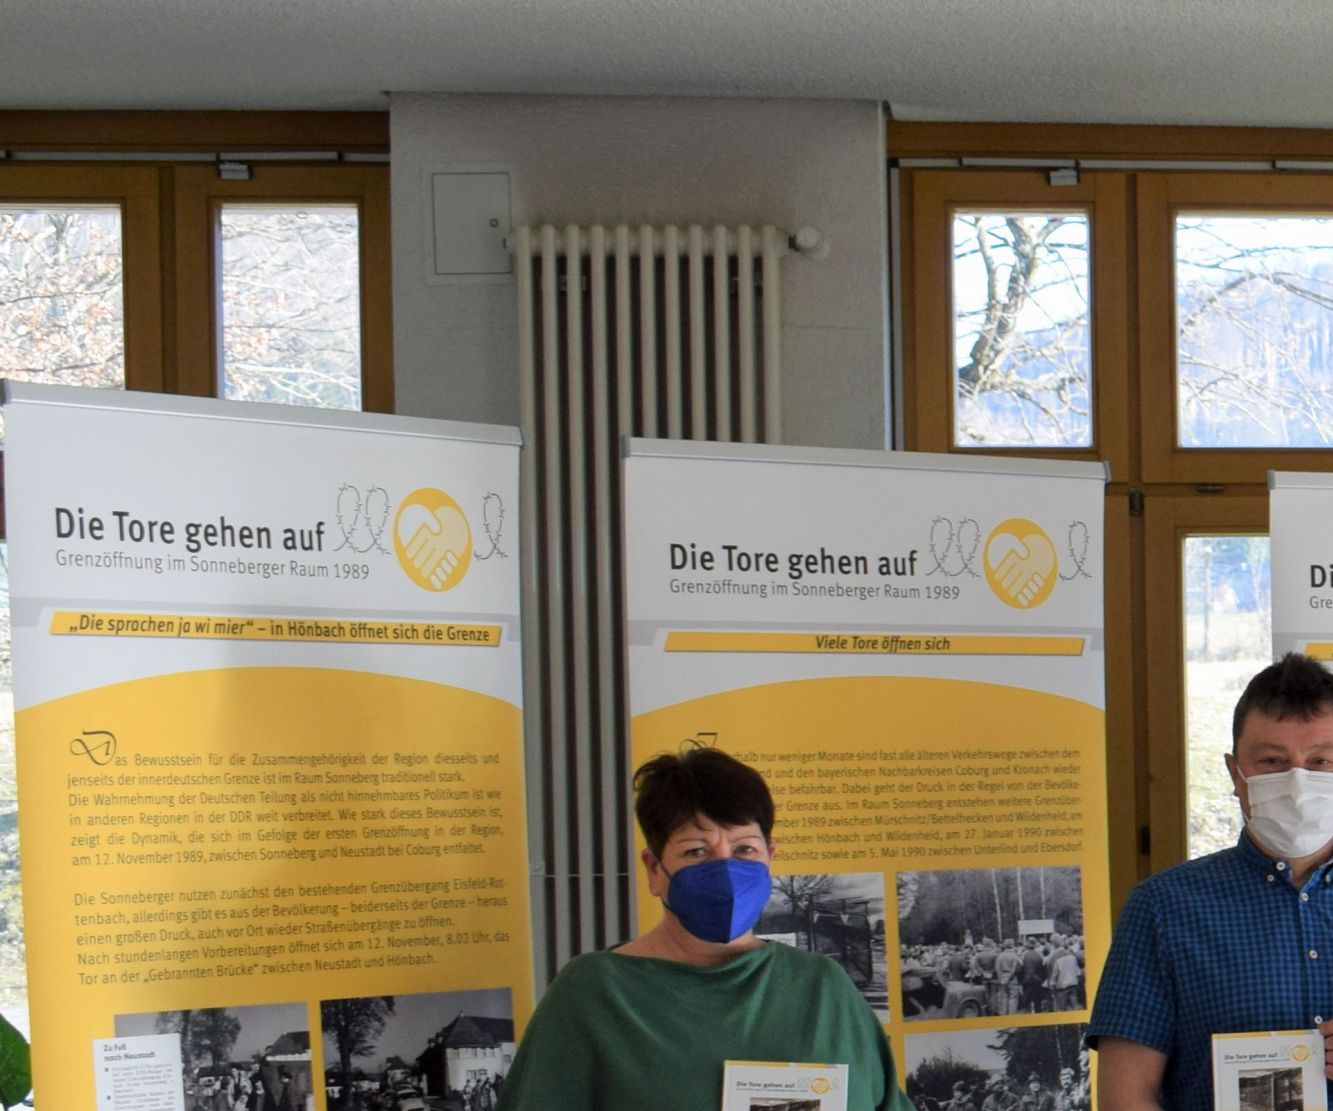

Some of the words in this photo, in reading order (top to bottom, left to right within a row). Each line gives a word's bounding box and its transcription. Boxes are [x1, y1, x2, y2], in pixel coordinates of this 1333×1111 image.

[54, 506, 105, 541] Die
[111, 509, 176, 545] Tore
[184, 515, 272, 552] gehen
[281, 520, 326, 552] auf
[54, 547, 164, 575] Grenzöffnung
[166, 552, 186, 572] im
[189, 554, 286, 580] Sonneberger
[288, 559, 329, 578] Raum
[332, 562, 370, 581] 1989
[669, 541, 715, 572] Die
[720, 544, 780, 574] Tore
[787, 546, 869, 578] gehen
[877, 548, 918, 577] auf
[668, 577, 769, 599] Grenzöffnung
[770, 579, 789, 596] im
[791, 580, 881, 601] Sonneberger
[882, 582, 921, 599] Raum
[924, 584, 961, 601] 1989
[69, 614, 104, 632] „Die
[107, 616, 175, 636] sprachen
[176, 618, 192, 637] ja
[194, 620, 211, 634] wi
[213, 619, 254, 635] mier“
[269, 622, 284, 635] in
[288, 620, 346, 637] Hönbach
[349, 622, 390, 640] öffnet
[393, 624, 419, 640] sich
[423, 624, 444, 641] die
[447, 625, 491, 642] Grenze
[813, 634, 849, 654] Viele
[850, 634, 879, 654] Tore
[880, 634, 922, 654] öffnen
[923, 635, 951, 651] sich
